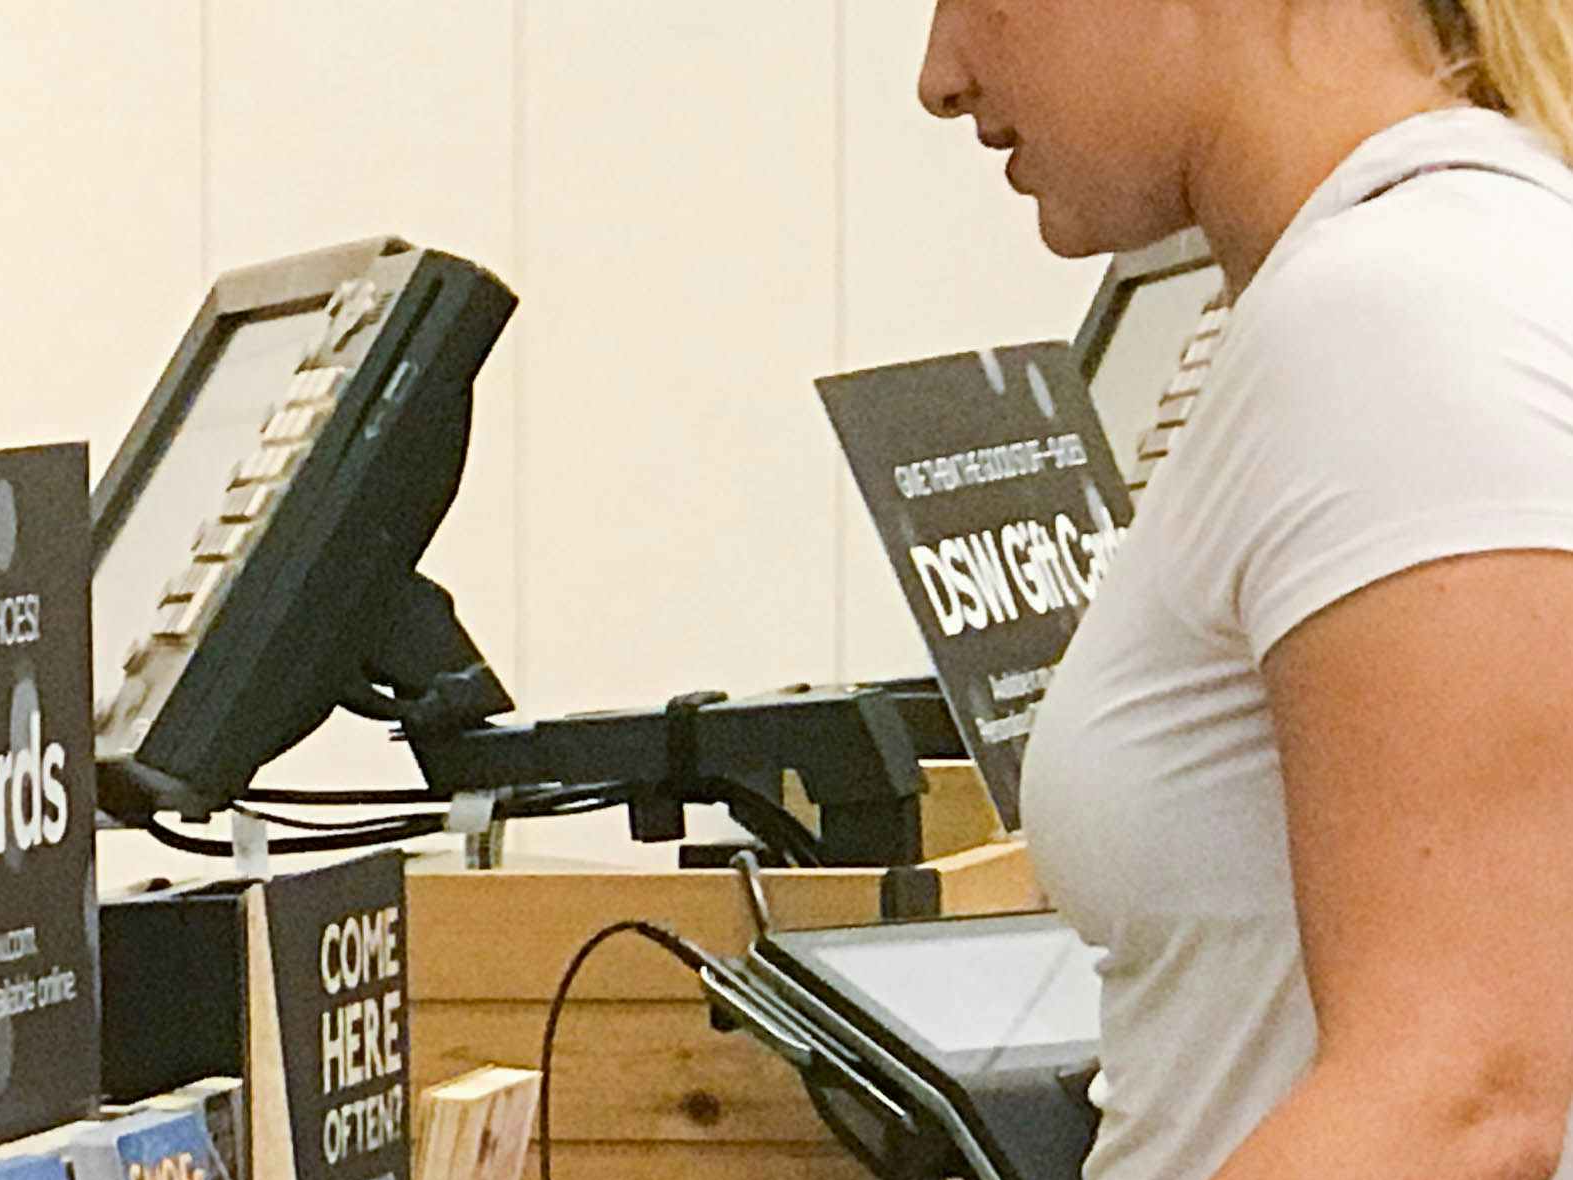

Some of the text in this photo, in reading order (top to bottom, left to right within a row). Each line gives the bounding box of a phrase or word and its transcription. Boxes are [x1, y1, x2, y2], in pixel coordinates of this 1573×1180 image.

[909, 530, 1019, 636] DSW
[1001, 519, 1079, 614] Gift
[321, 907, 401, 995] COME
[321, 990, 402, 1094] HERE
[323, 1083, 403, 1165] OFTEN?
